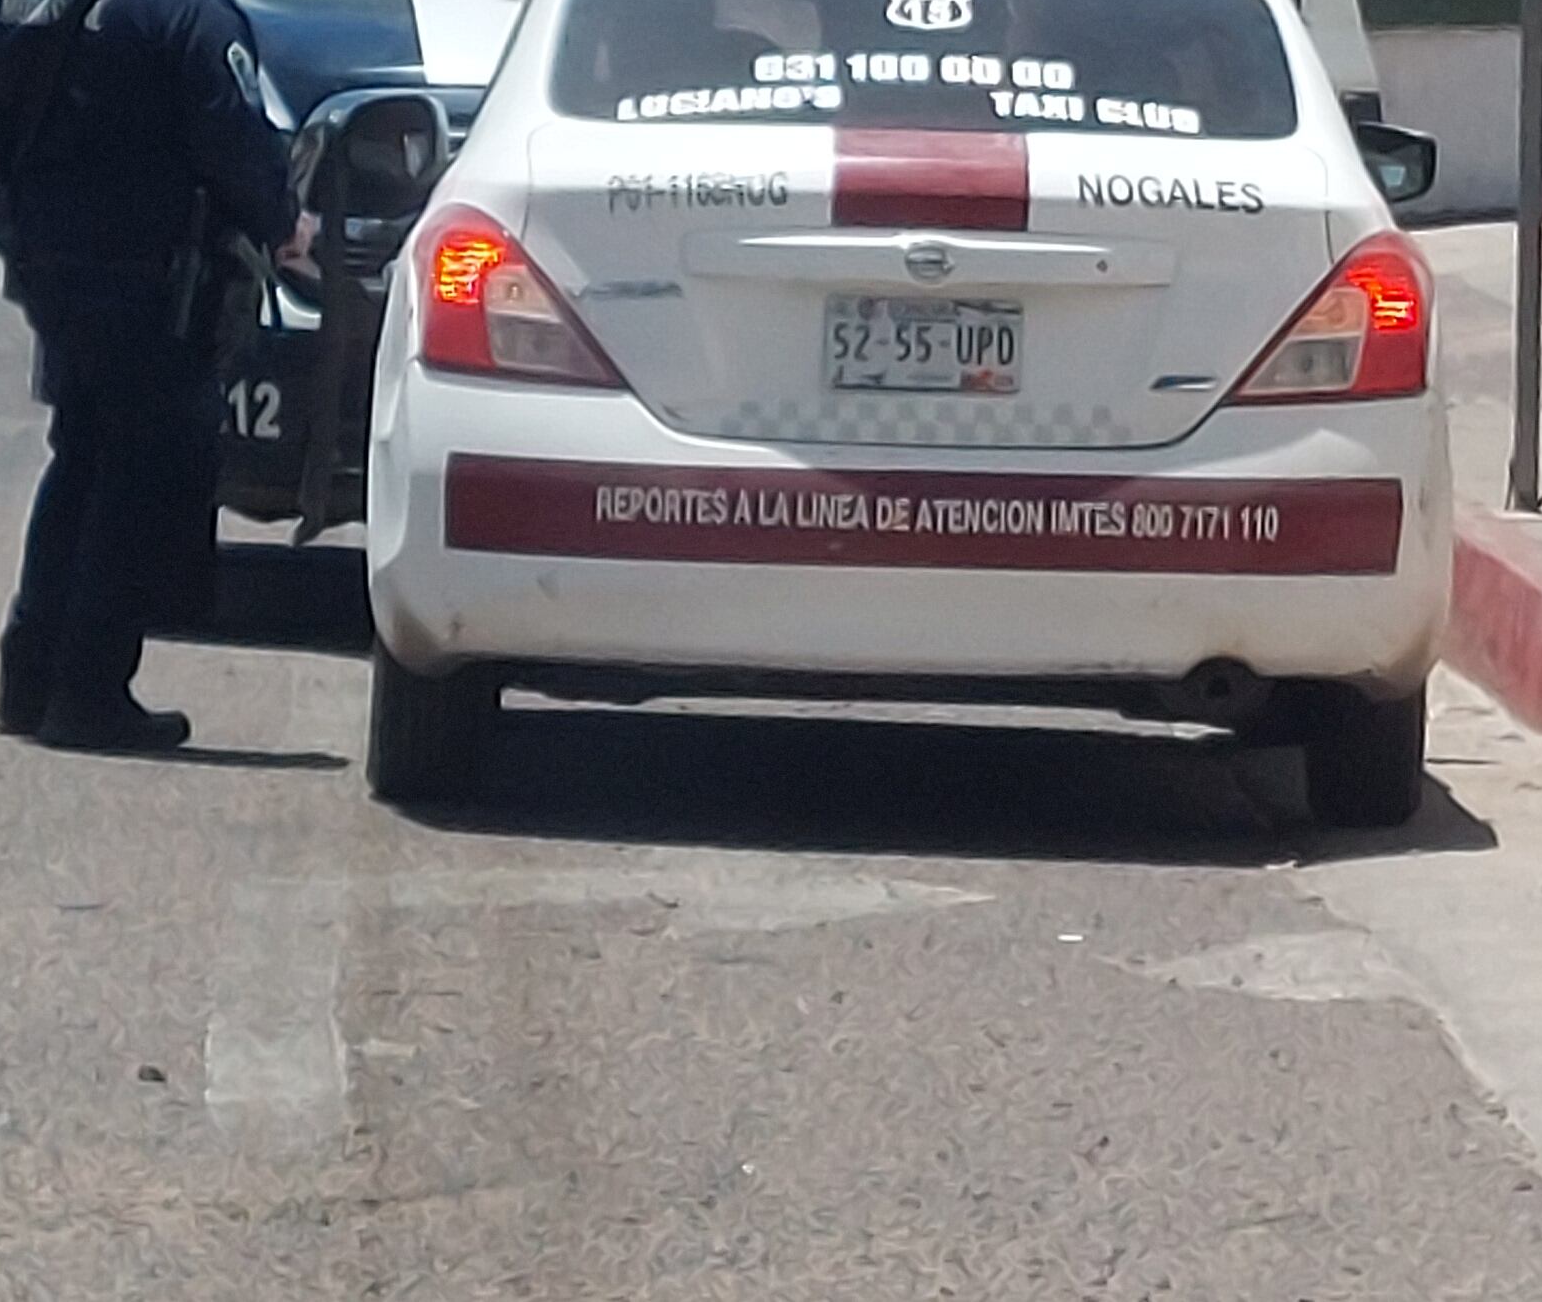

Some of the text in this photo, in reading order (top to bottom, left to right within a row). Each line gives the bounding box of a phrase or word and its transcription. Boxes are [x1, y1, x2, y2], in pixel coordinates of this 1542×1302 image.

[846, 53, 930, 83] 100
[988, 91, 1085, 122] TAXI
[1095, 97, 1200, 135] CLUB
[1077, 173, 1265, 215] NOGALES
[595, 485, 728, 526] REPORTES
[733, 488, 752, 526] A
[758, 489, 790, 528] LA
[795, 492, 870, 531] LINEA
[875, 496, 910, 532] DE
[914, 498, 1044, 536] ATENCION
[1131, 502, 1174, 539] 800
[1179, 504, 1231, 541] 7171
[1240, 504, 1280, 543] 110
